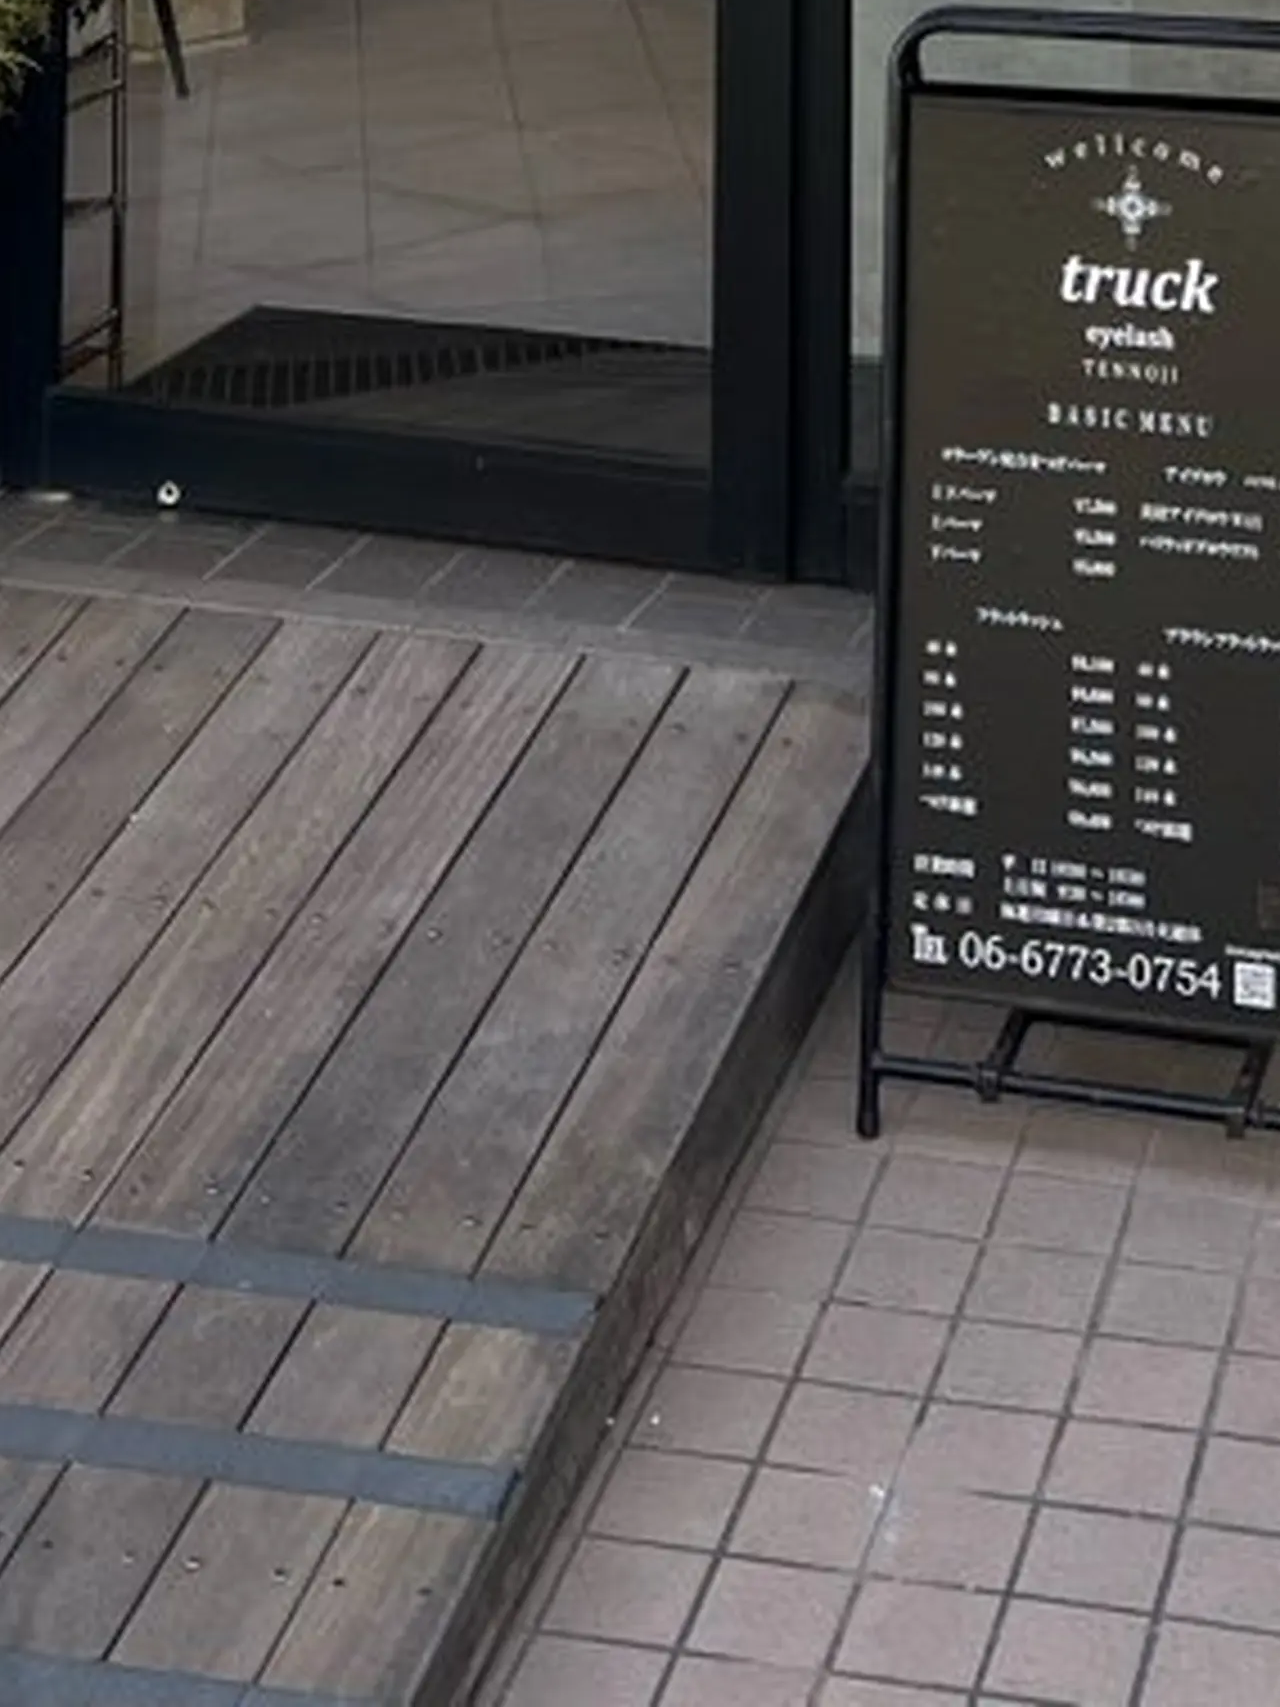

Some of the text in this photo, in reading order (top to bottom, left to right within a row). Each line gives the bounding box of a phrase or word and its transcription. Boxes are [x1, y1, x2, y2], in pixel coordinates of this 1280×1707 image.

[1044, 132, 1226, 185] wellcome
[1059, 253, 1220, 315] truck
[1084, 322, 1176, 352] eyelash
[1047, 401, 1214, 438] BASIC MENU
[958, 930, 1222, 1000] 06-6773-0754
